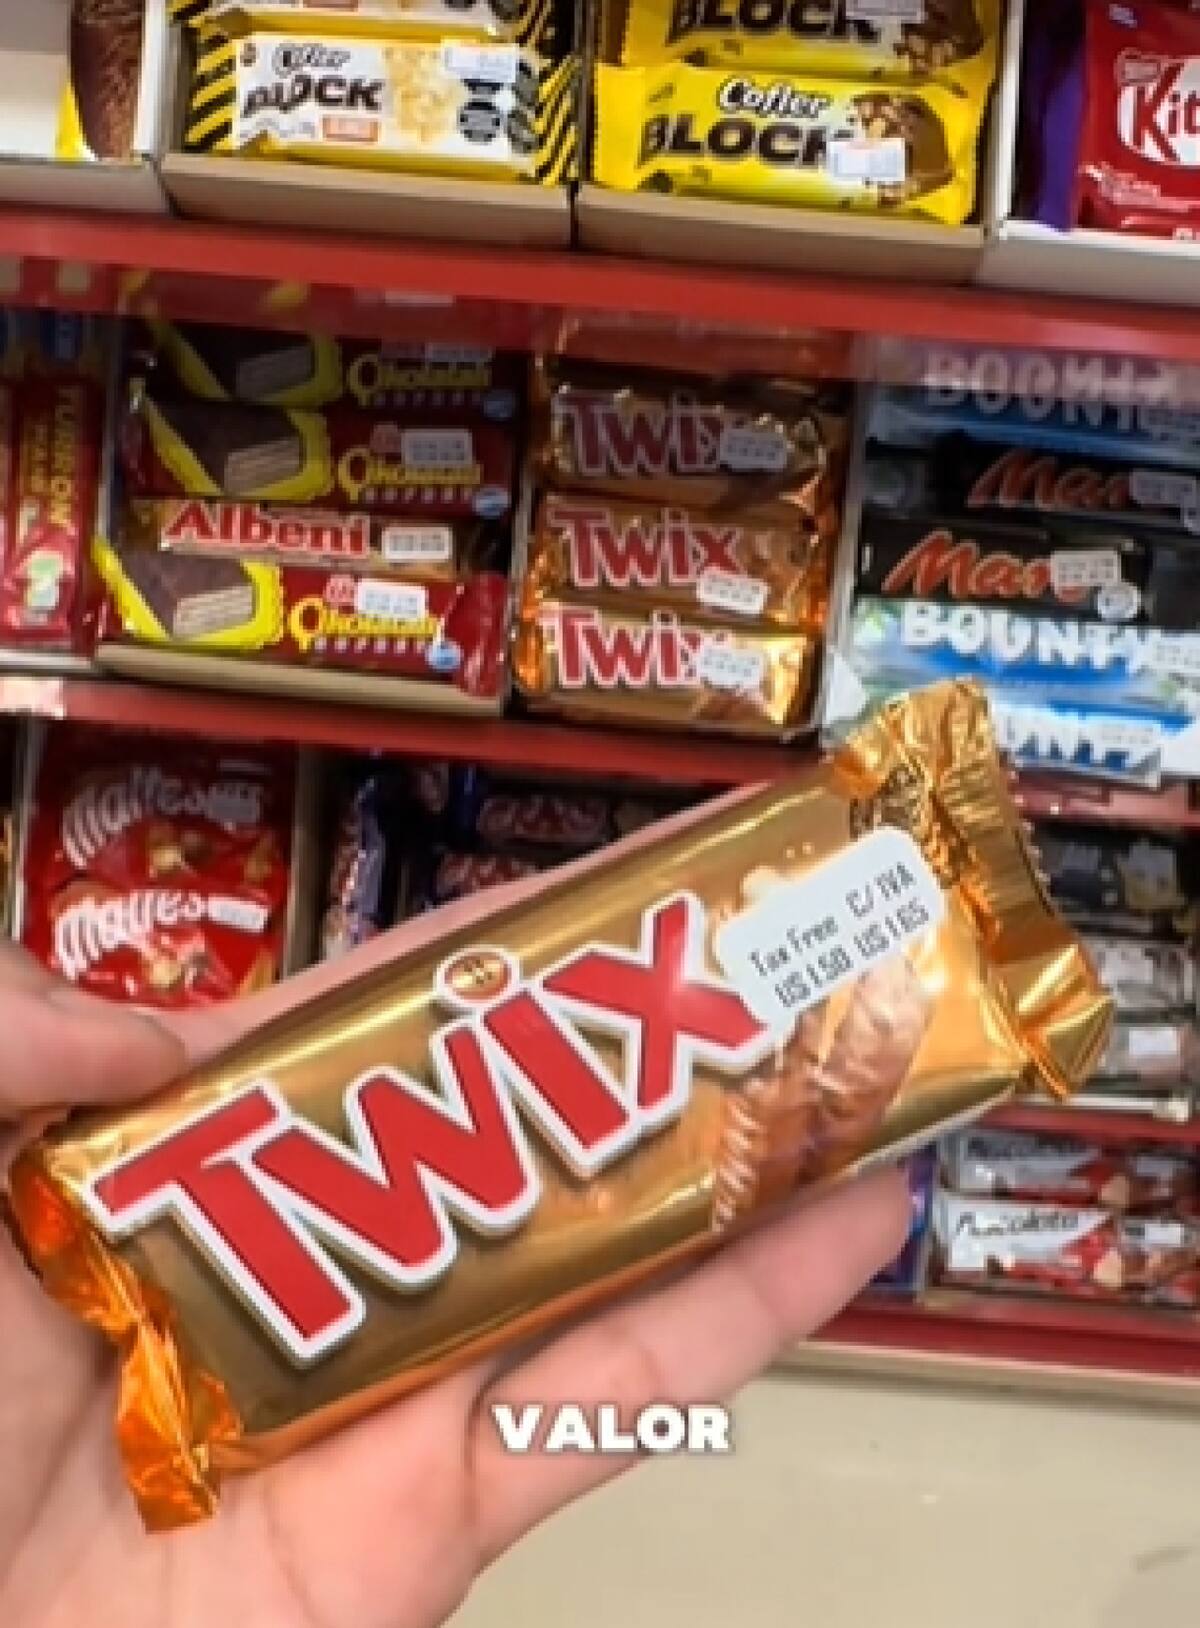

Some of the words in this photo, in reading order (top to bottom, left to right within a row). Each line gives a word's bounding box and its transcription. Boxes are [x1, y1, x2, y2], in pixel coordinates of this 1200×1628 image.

[966, 449, 1133, 512] Mar
[547, 501, 743, 588] Twix
[86, 891, 772, 1368] Twix
